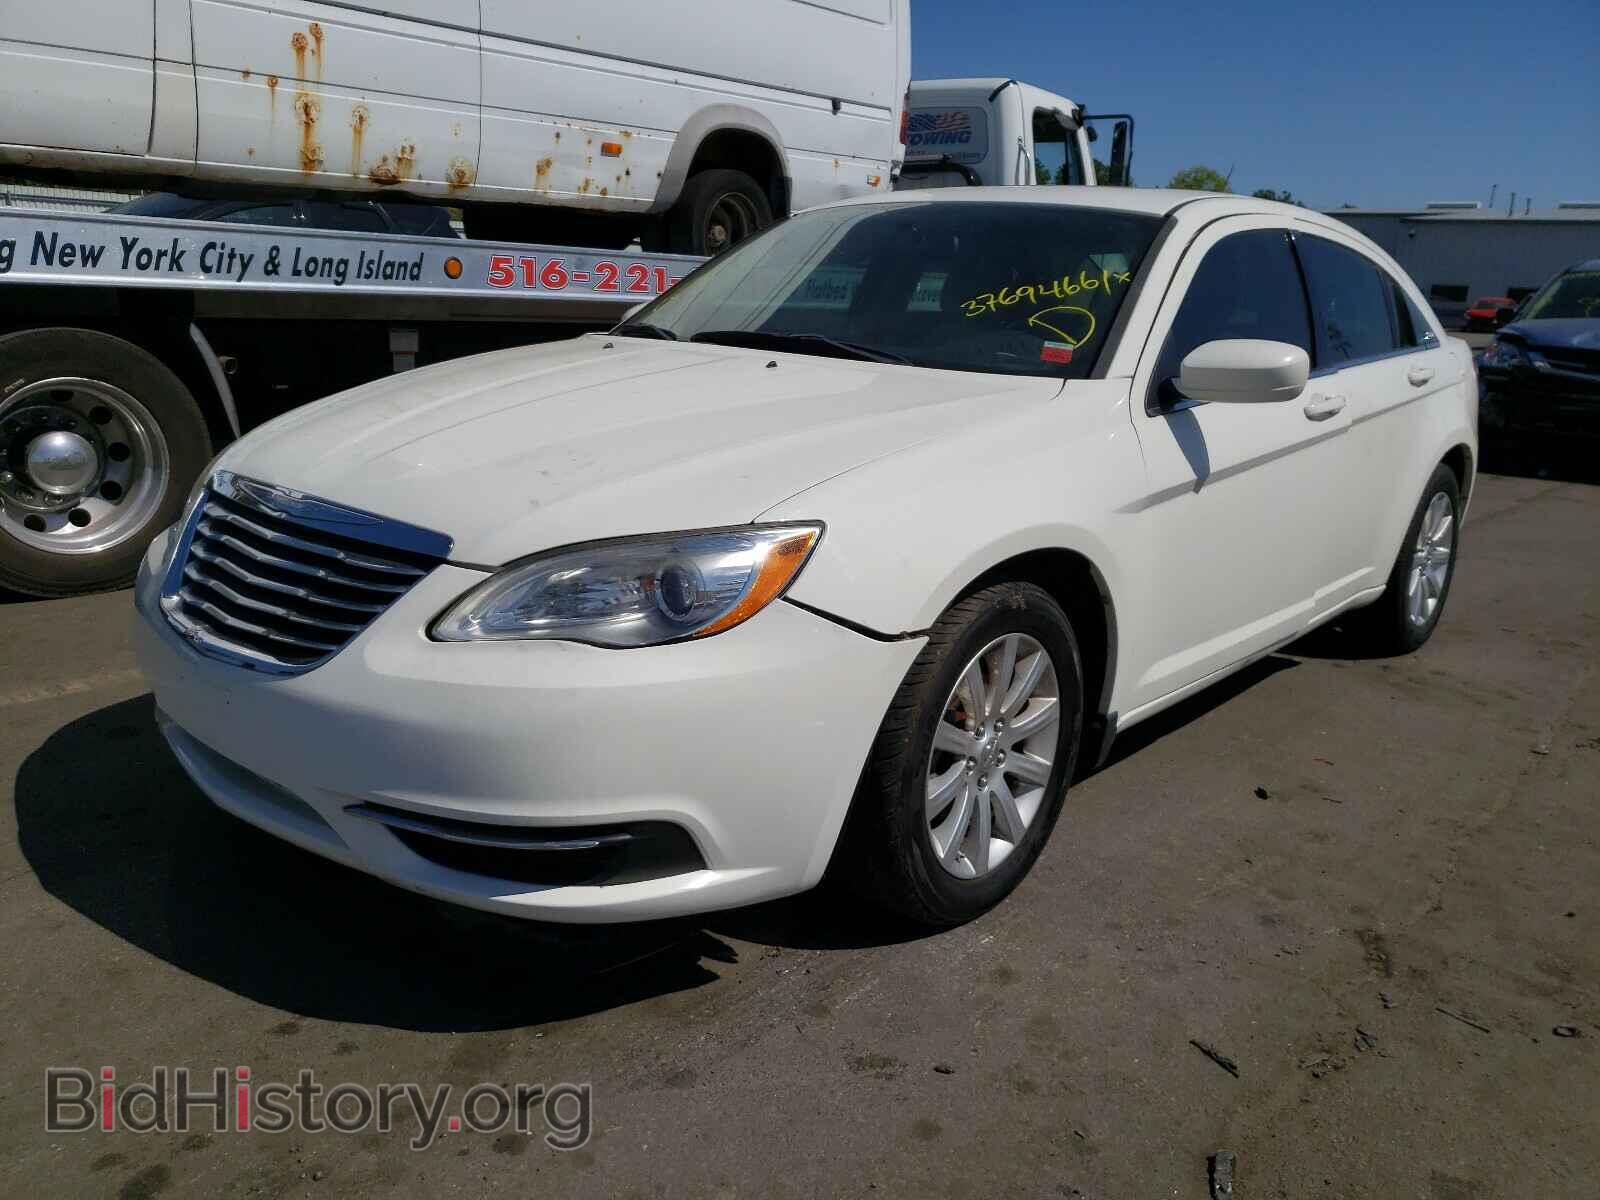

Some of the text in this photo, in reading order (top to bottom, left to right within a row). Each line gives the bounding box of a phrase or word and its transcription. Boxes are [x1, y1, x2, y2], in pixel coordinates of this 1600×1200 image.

[30, 230, 106, 269] New
[119, 236, 186, 272] York
[199, 241, 254, 282] City
[264, 245, 281, 276] &
[292, 247, 349, 286] Long
[356, 250, 424, 281] Island
